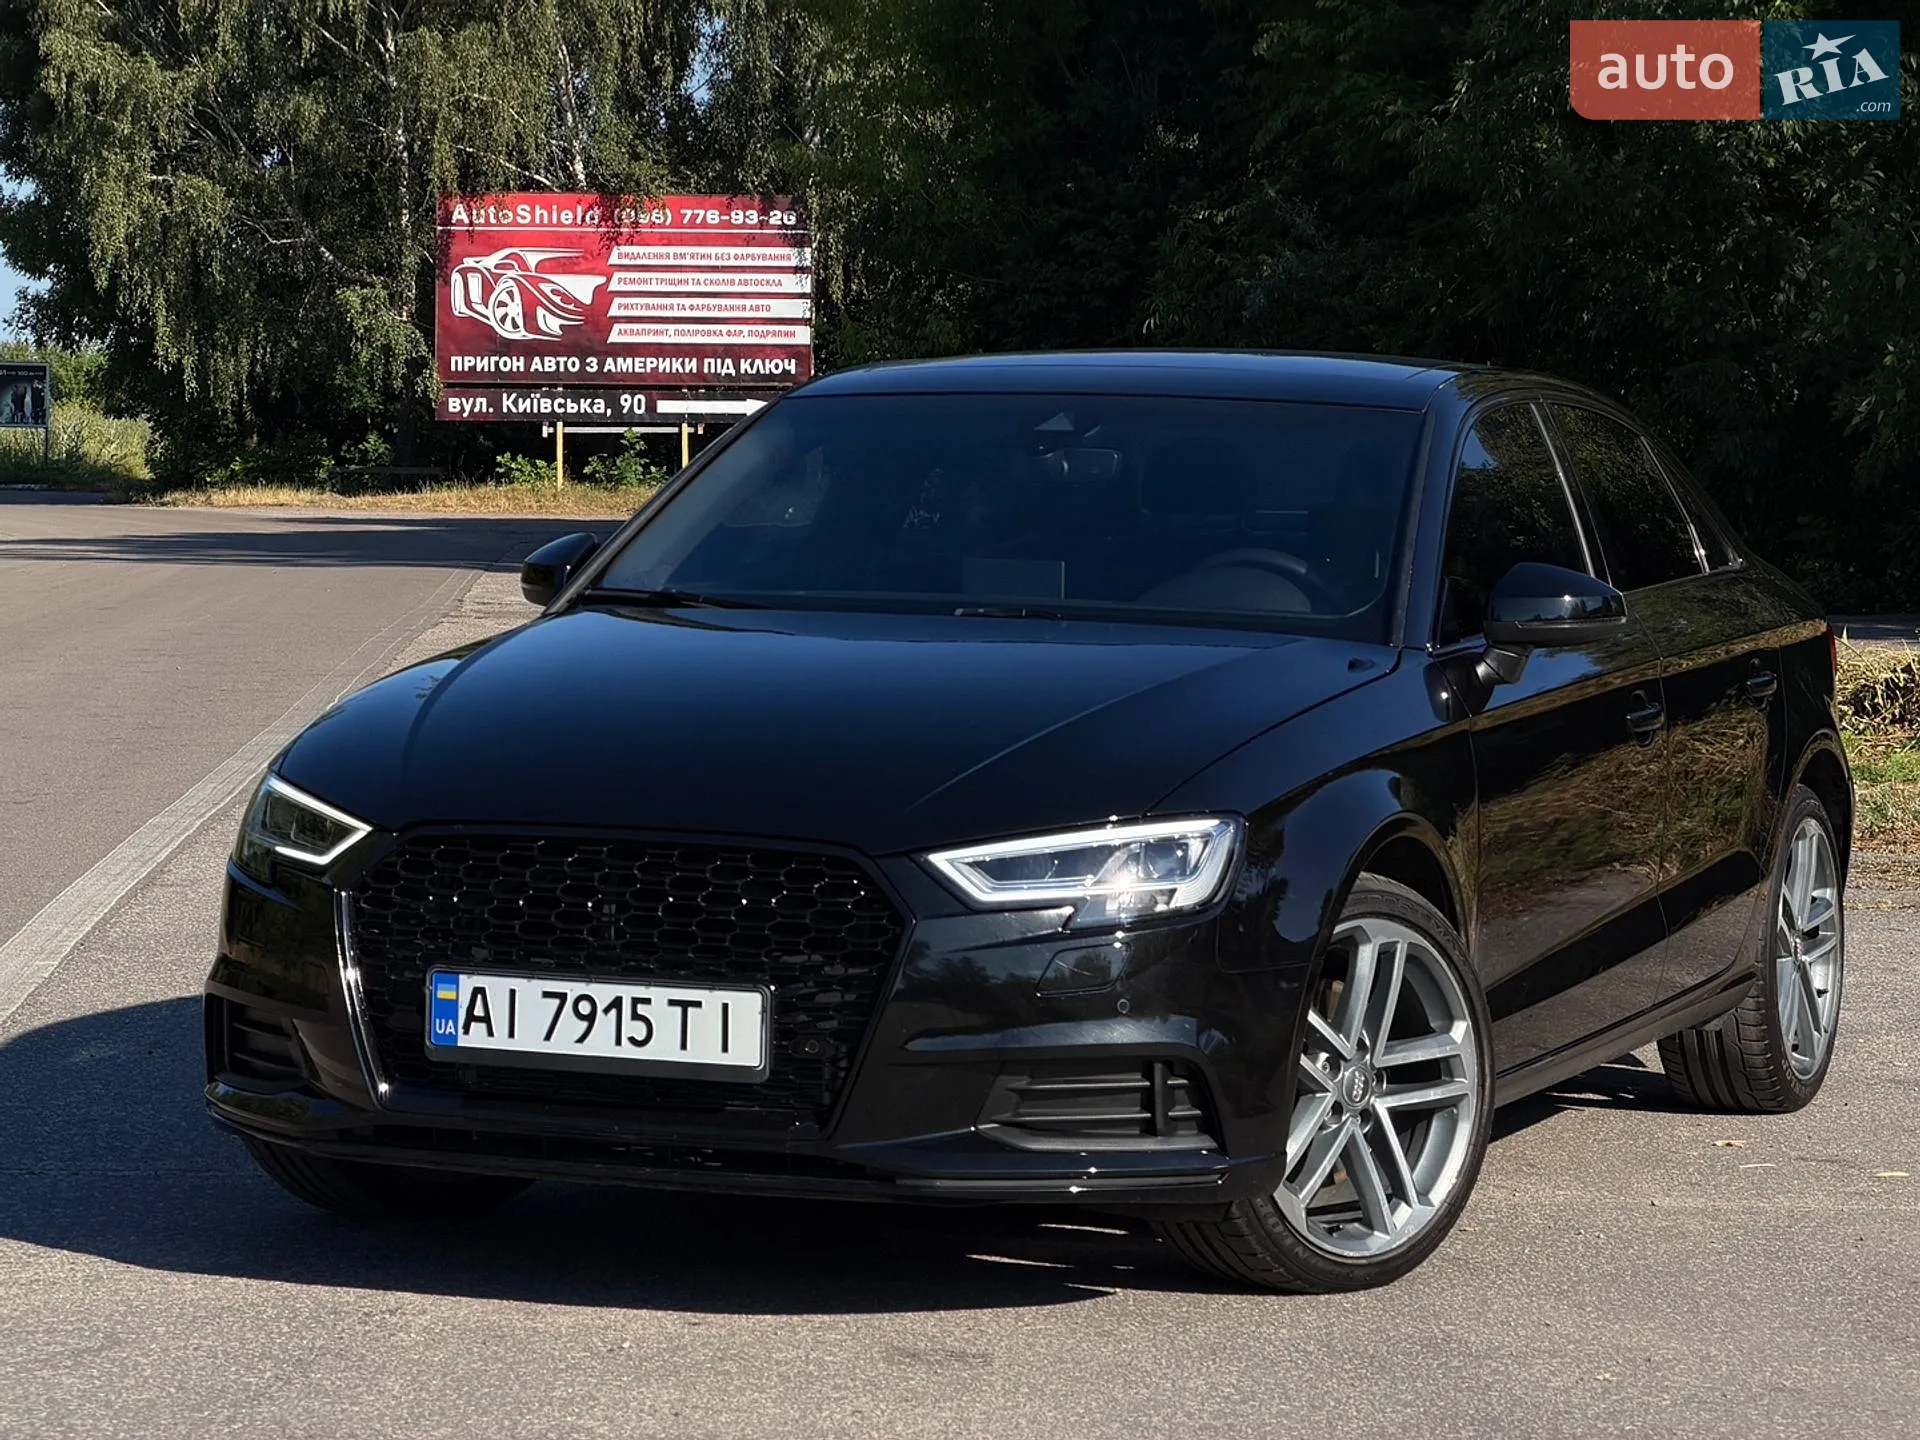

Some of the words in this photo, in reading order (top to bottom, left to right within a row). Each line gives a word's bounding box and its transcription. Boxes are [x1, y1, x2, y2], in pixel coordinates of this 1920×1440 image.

[451, 203, 600, 225] AutoShield
[680, 209, 797, 225] 776-93-26
[617, 251, 671, 262] ВИДАЛЕННЯ
[673, 252, 712, 261] ВМ'ЯТИН
[714, 252, 731, 262] БЕЗ
[733, 253, 792, 262] ФАРБУВАННЯ
[617, 277, 653, 286] РЕМОНТ
[654, 278, 689, 287] ТРІЩИН
[691, 278, 702, 287] ТА
[703, 278, 738, 287] СКОЛІВ
[739, 279, 783, 288] АВТОСКЛА
[617, 302, 674, 312] РИХТУВАННЯ
[676, 303, 687, 312] ТА
[688, 303, 747, 313] ФАРБУВАННЯ
[748, 304, 772, 312] АВТО
[617, 328, 672, 339] АКВАПРИНТ,
[674, 328, 724, 338] ПОЛІРОВКА
[725, 329, 746, 340] ФАР,
[747, 330, 796, 340] ПОДРЯПИН
[450, 355, 525, 372] ПРИГОН
[530, 356, 581, 373] АВТО
[585, 356, 599, 373] З
[603, 357, 697, 374] АМЕРИКИ
[703, 357, 736, 377] ПІД
[740, 358, 797, 375] КЛЮЧ
[448, 396, 494, 417] вул.
[502, 392, 612, 417] Київська,
[619, 393, 646, 415] 90
[435, 1018, 456, 1036] UA
[462, 985, 517, 1039] AI
[541, 989, 653, 1049] 7915
[667, 997, 730, 1054] TI
